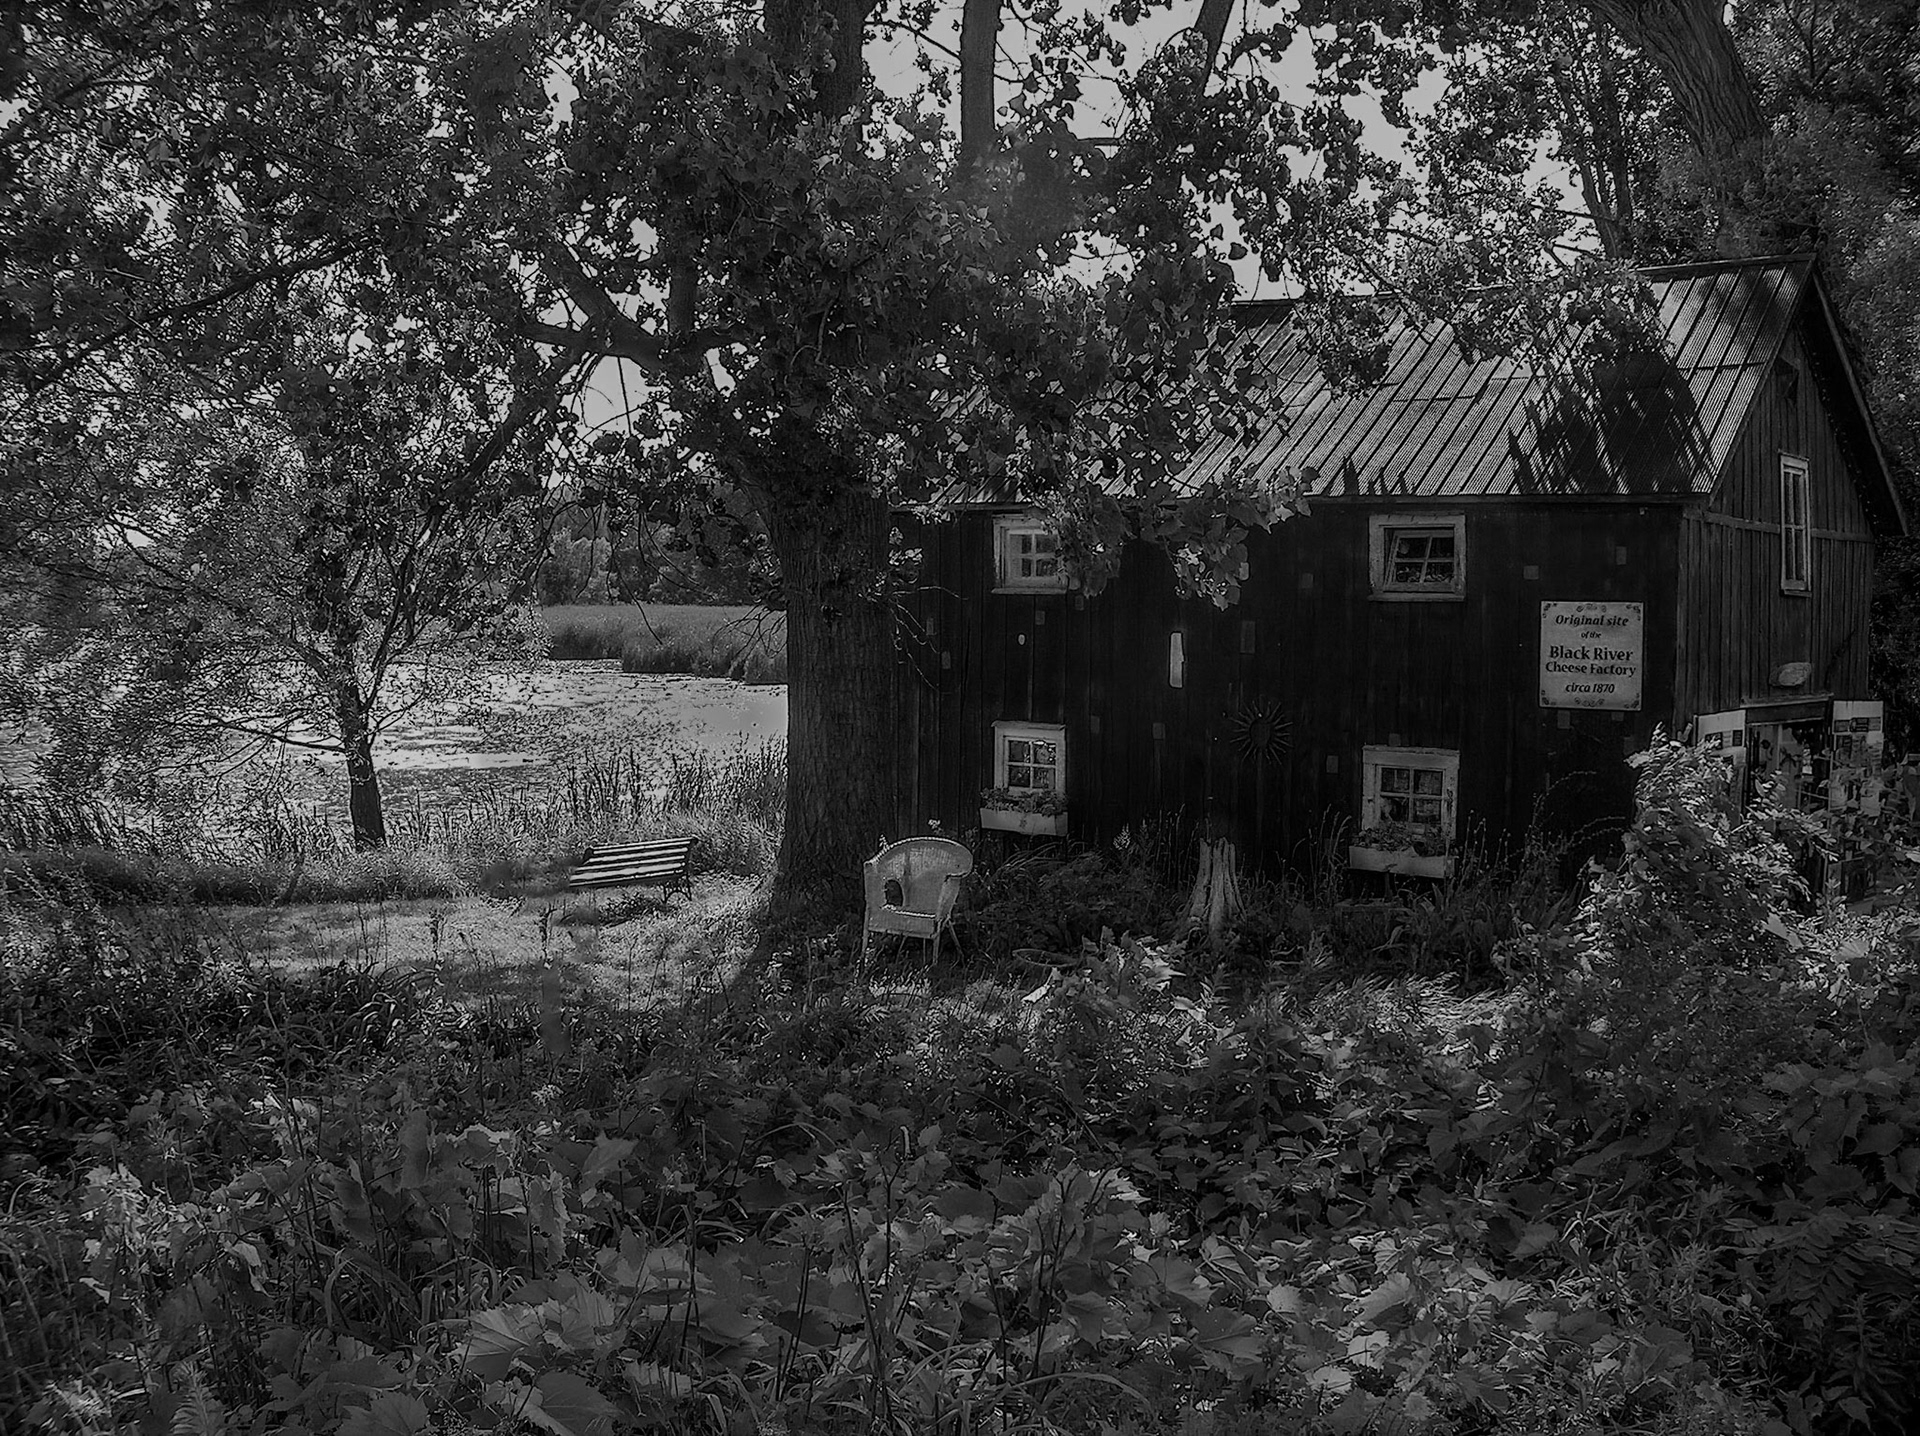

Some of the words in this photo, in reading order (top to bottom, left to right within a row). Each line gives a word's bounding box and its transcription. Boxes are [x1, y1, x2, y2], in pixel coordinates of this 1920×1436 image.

[1555, 614, 1604, 628] Original
[1607, 615, 1629, 627] site
[1580, 631, 1589, 639] of
[1590, 631, 1602, 639] the
[1549, 645, 1590, 660] Black
[1593, 647, 1634, 661] River
[1545, 661, 1588, 674] Cheese
[1590, 663, 1637, 678] Factory
[1565, 682, 1590, 693] circa
[1592, 683, 1615, 694] 1870
